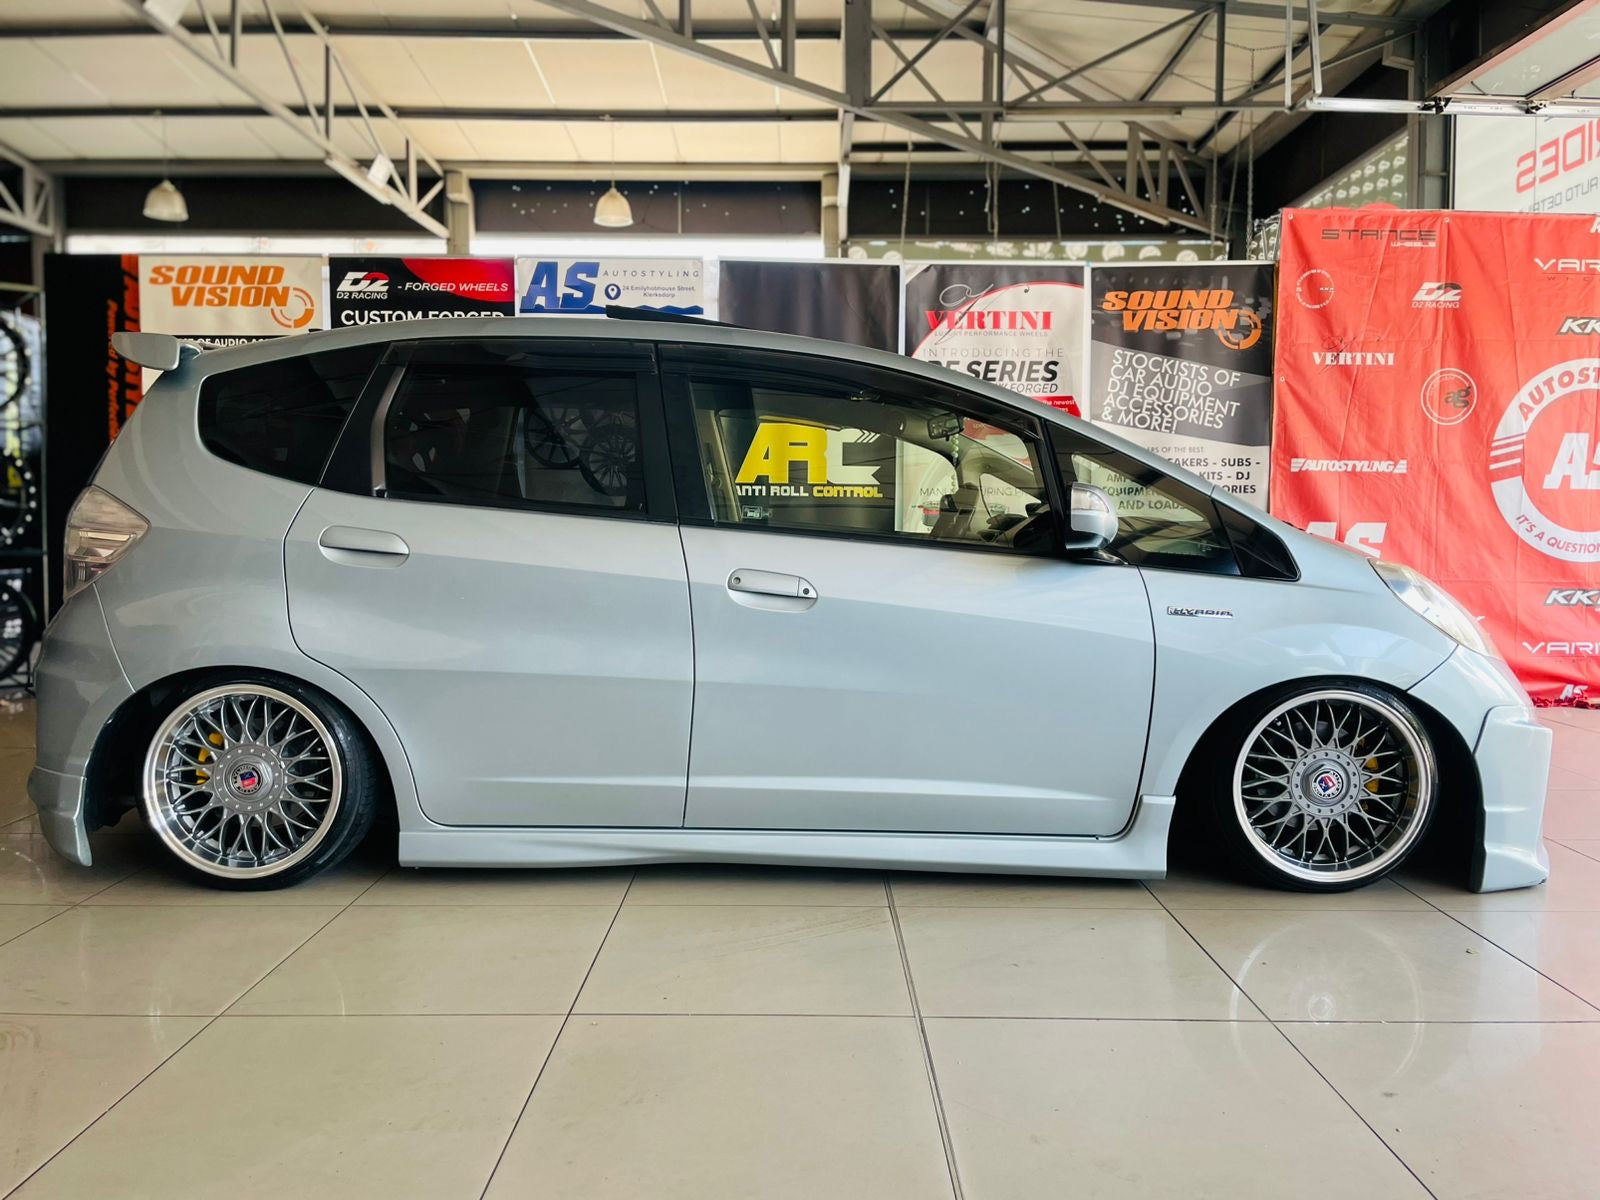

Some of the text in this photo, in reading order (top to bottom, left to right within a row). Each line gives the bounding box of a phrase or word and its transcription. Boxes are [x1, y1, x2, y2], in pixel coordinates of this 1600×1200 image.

[1321, 229, 1437, 241] STANCE
[149, 265, 285, 285] SOUND
[602, 270, 700, 278] AUTOSTYLING
[404, 282, 456, 292] FORGED
[458, 282, 509, 293] WHEELS
[521, 261, 600, 310] AS
[171, 286, 290, 307] VISION
[336, 292, 389, 300] D2 RACING
[1102, 289, 1234, 310] SOUND
[340, 310, 424, 326] CUSTOM
[926, 310, 1052, 330] VERTINI
[1122, 309, 1240, 330] VISION
[923, 347, 1065, 358] INTRODUCING THE
[1312, 351, 1396, 366] VERTINI
[966, 361, 1060, 382] SERIES
[1112, 350, 1241, 387] STOCKISTS OF
[1110, 364, 1212, 397] CAR AUDIO
[1107, 377, 1240, 417] DJ EQUIPMENT
[1101, 406, 1178, 434] & MORE!
[1103, 393, 1225, 430] ACCESSORIES
[1221, 458, 1252, 467] SUBS
[1301, 459, 1396, 472] AUTOSTYLING
[1199, 472, 1224, 480] KITS
[1236, 471, 1250, 480] DJ
[770, 485, 809, 497] ROLL
[812, 486, 883, 498] CONTROL
[1118, 500, 1145, 510] AND
[1516, 514, 1536, 533] IT'S
[1534, 531, 1546, 542] A
[1544, 588, 1600, 607] KK
[1521, 641, 1600, 656] VAR
